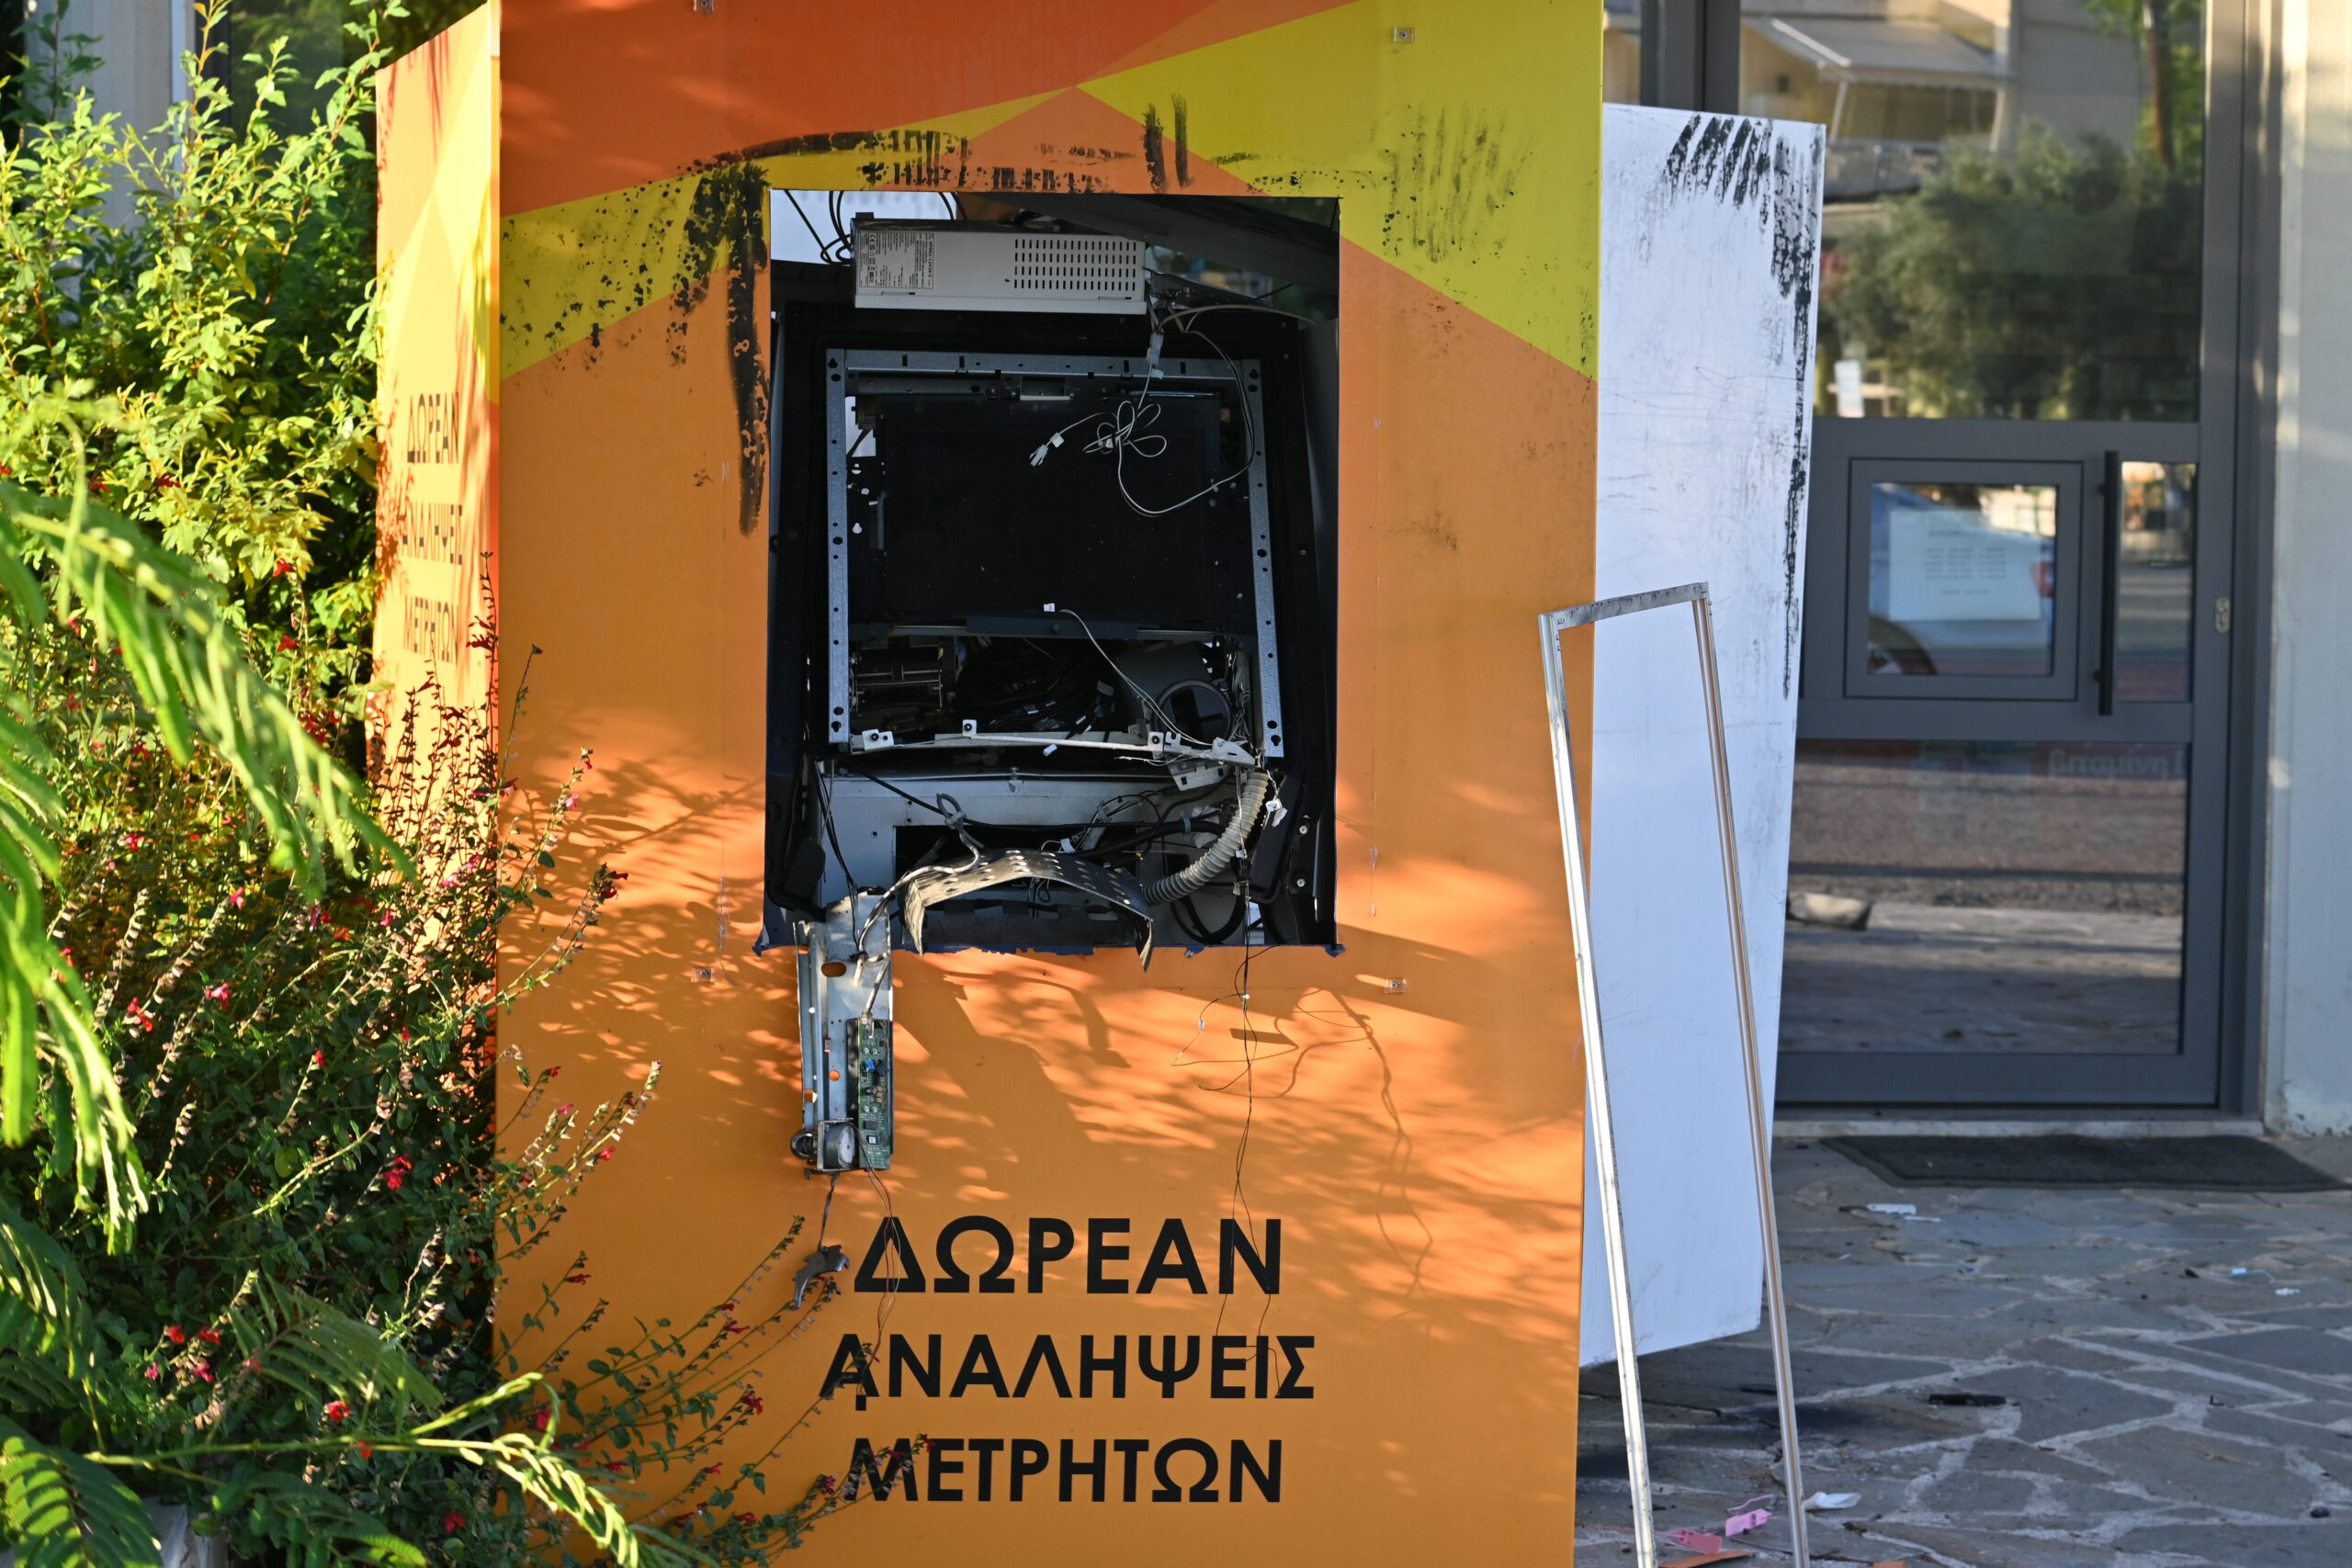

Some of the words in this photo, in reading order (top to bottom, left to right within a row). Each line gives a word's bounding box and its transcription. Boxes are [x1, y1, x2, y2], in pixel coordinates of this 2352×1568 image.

[407, 392, 459, 464] ΔΩΡΕΑΝ
[401, 501, 463, 566] ΑΝΑΛΗΨΕΙΣ
[402, 594, 458, 667] ΜΕΤΡΗΤΩΝ
[854, 1215, 1282, 1295] ΔΩΡΕΑΝ
[819, 1334, 1315, 1399] ΑΝΑΛΗΨΕΙΣ
[843, 1438, 1283, 1503] ΜΕΤΡΗΤΩΝ
